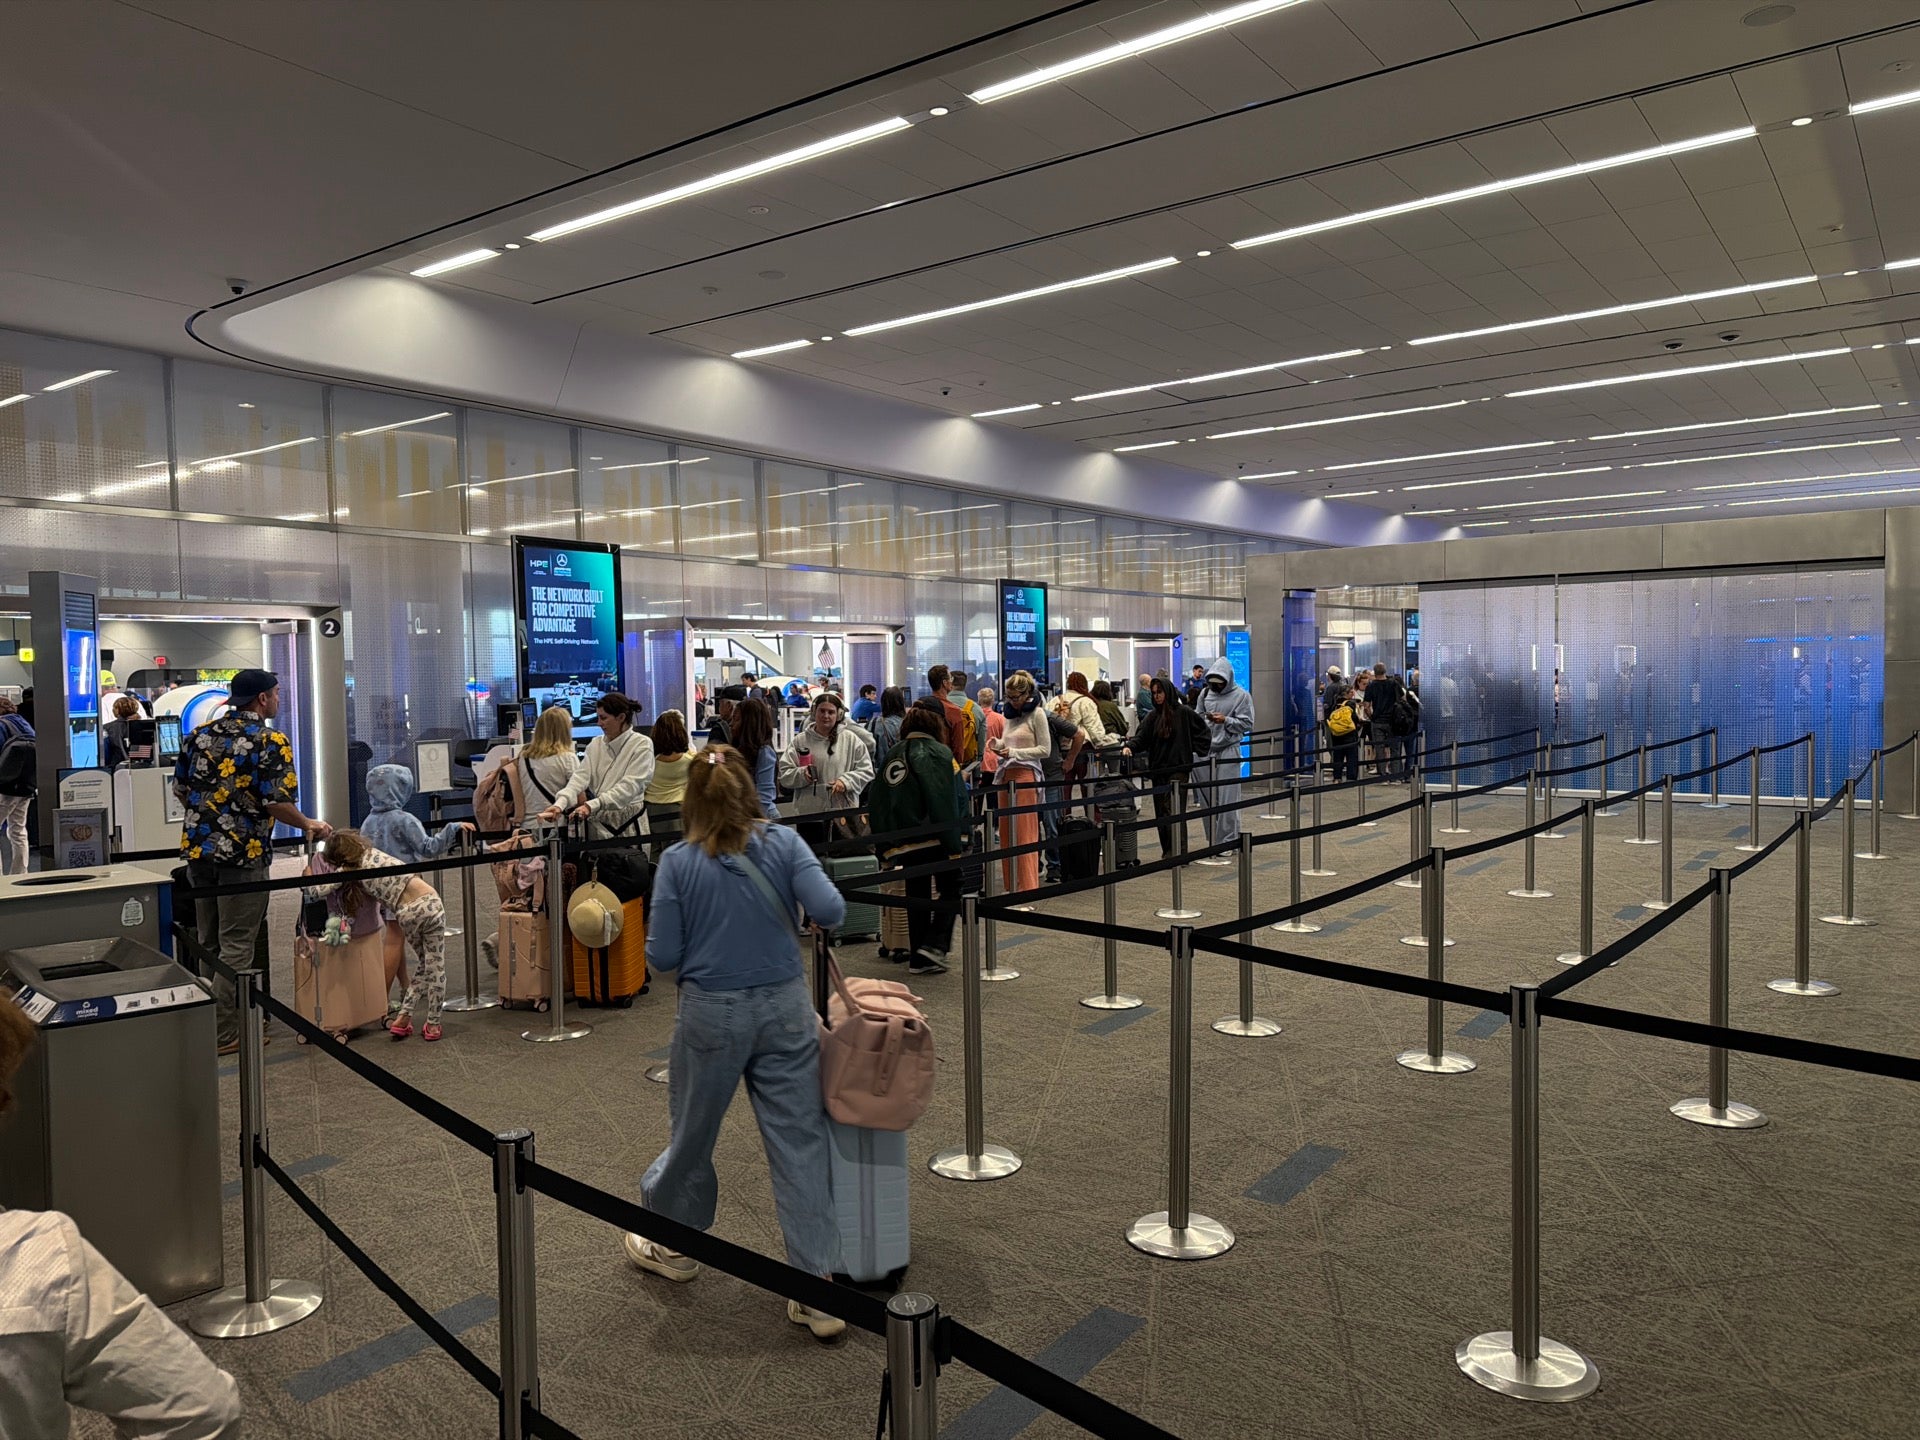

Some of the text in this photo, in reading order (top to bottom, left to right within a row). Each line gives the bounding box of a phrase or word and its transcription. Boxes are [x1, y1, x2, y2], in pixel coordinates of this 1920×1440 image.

[530, 560, 548, 568] HPE
[531, 586, 604, 604] THE NETWORK BUILT
[532, 602, 596, 618] FOR COMPETITIVE
[325, 621, 335, 635] 2
[533, 618, 576, 632] ADVANTAGE
[554, 638, 580, 646] Self-Driving
[896, 634, 903, 644] 4
[886, 760, 906, 785] G
[76, 1006, 99, 1015] mixed
